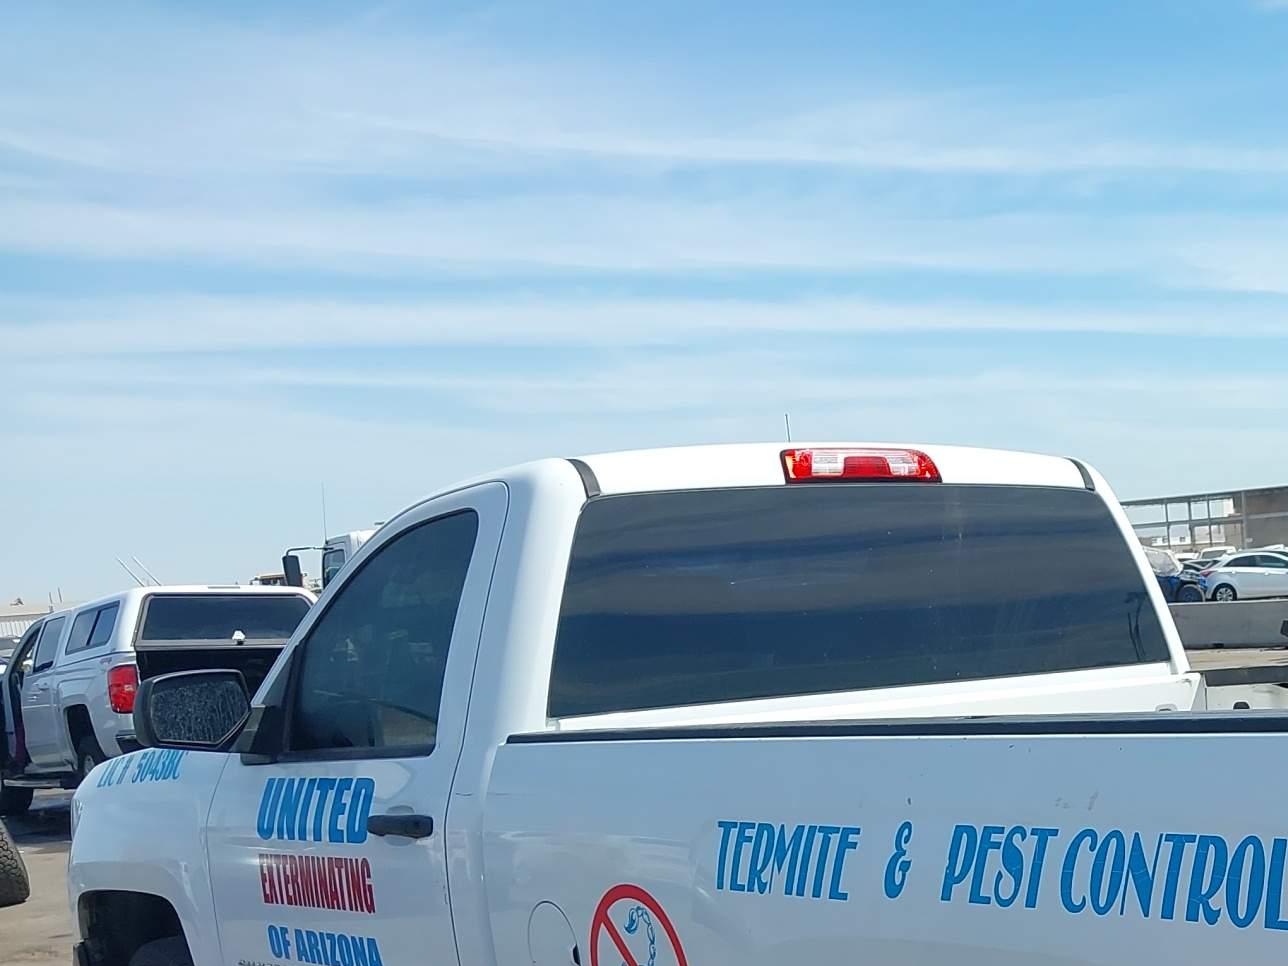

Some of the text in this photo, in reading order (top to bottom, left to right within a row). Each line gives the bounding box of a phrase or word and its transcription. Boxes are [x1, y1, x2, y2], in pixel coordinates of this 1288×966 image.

[257, 777, 376, 844] UNITED
[258, 853, 376, 914] EXTERMINATING
[717, 820, 861, 901] TERMITE
[884, 821, 912, 900] &
[940, 824, 1059, 910] PEST
[267, 924, 291, 960] OF
